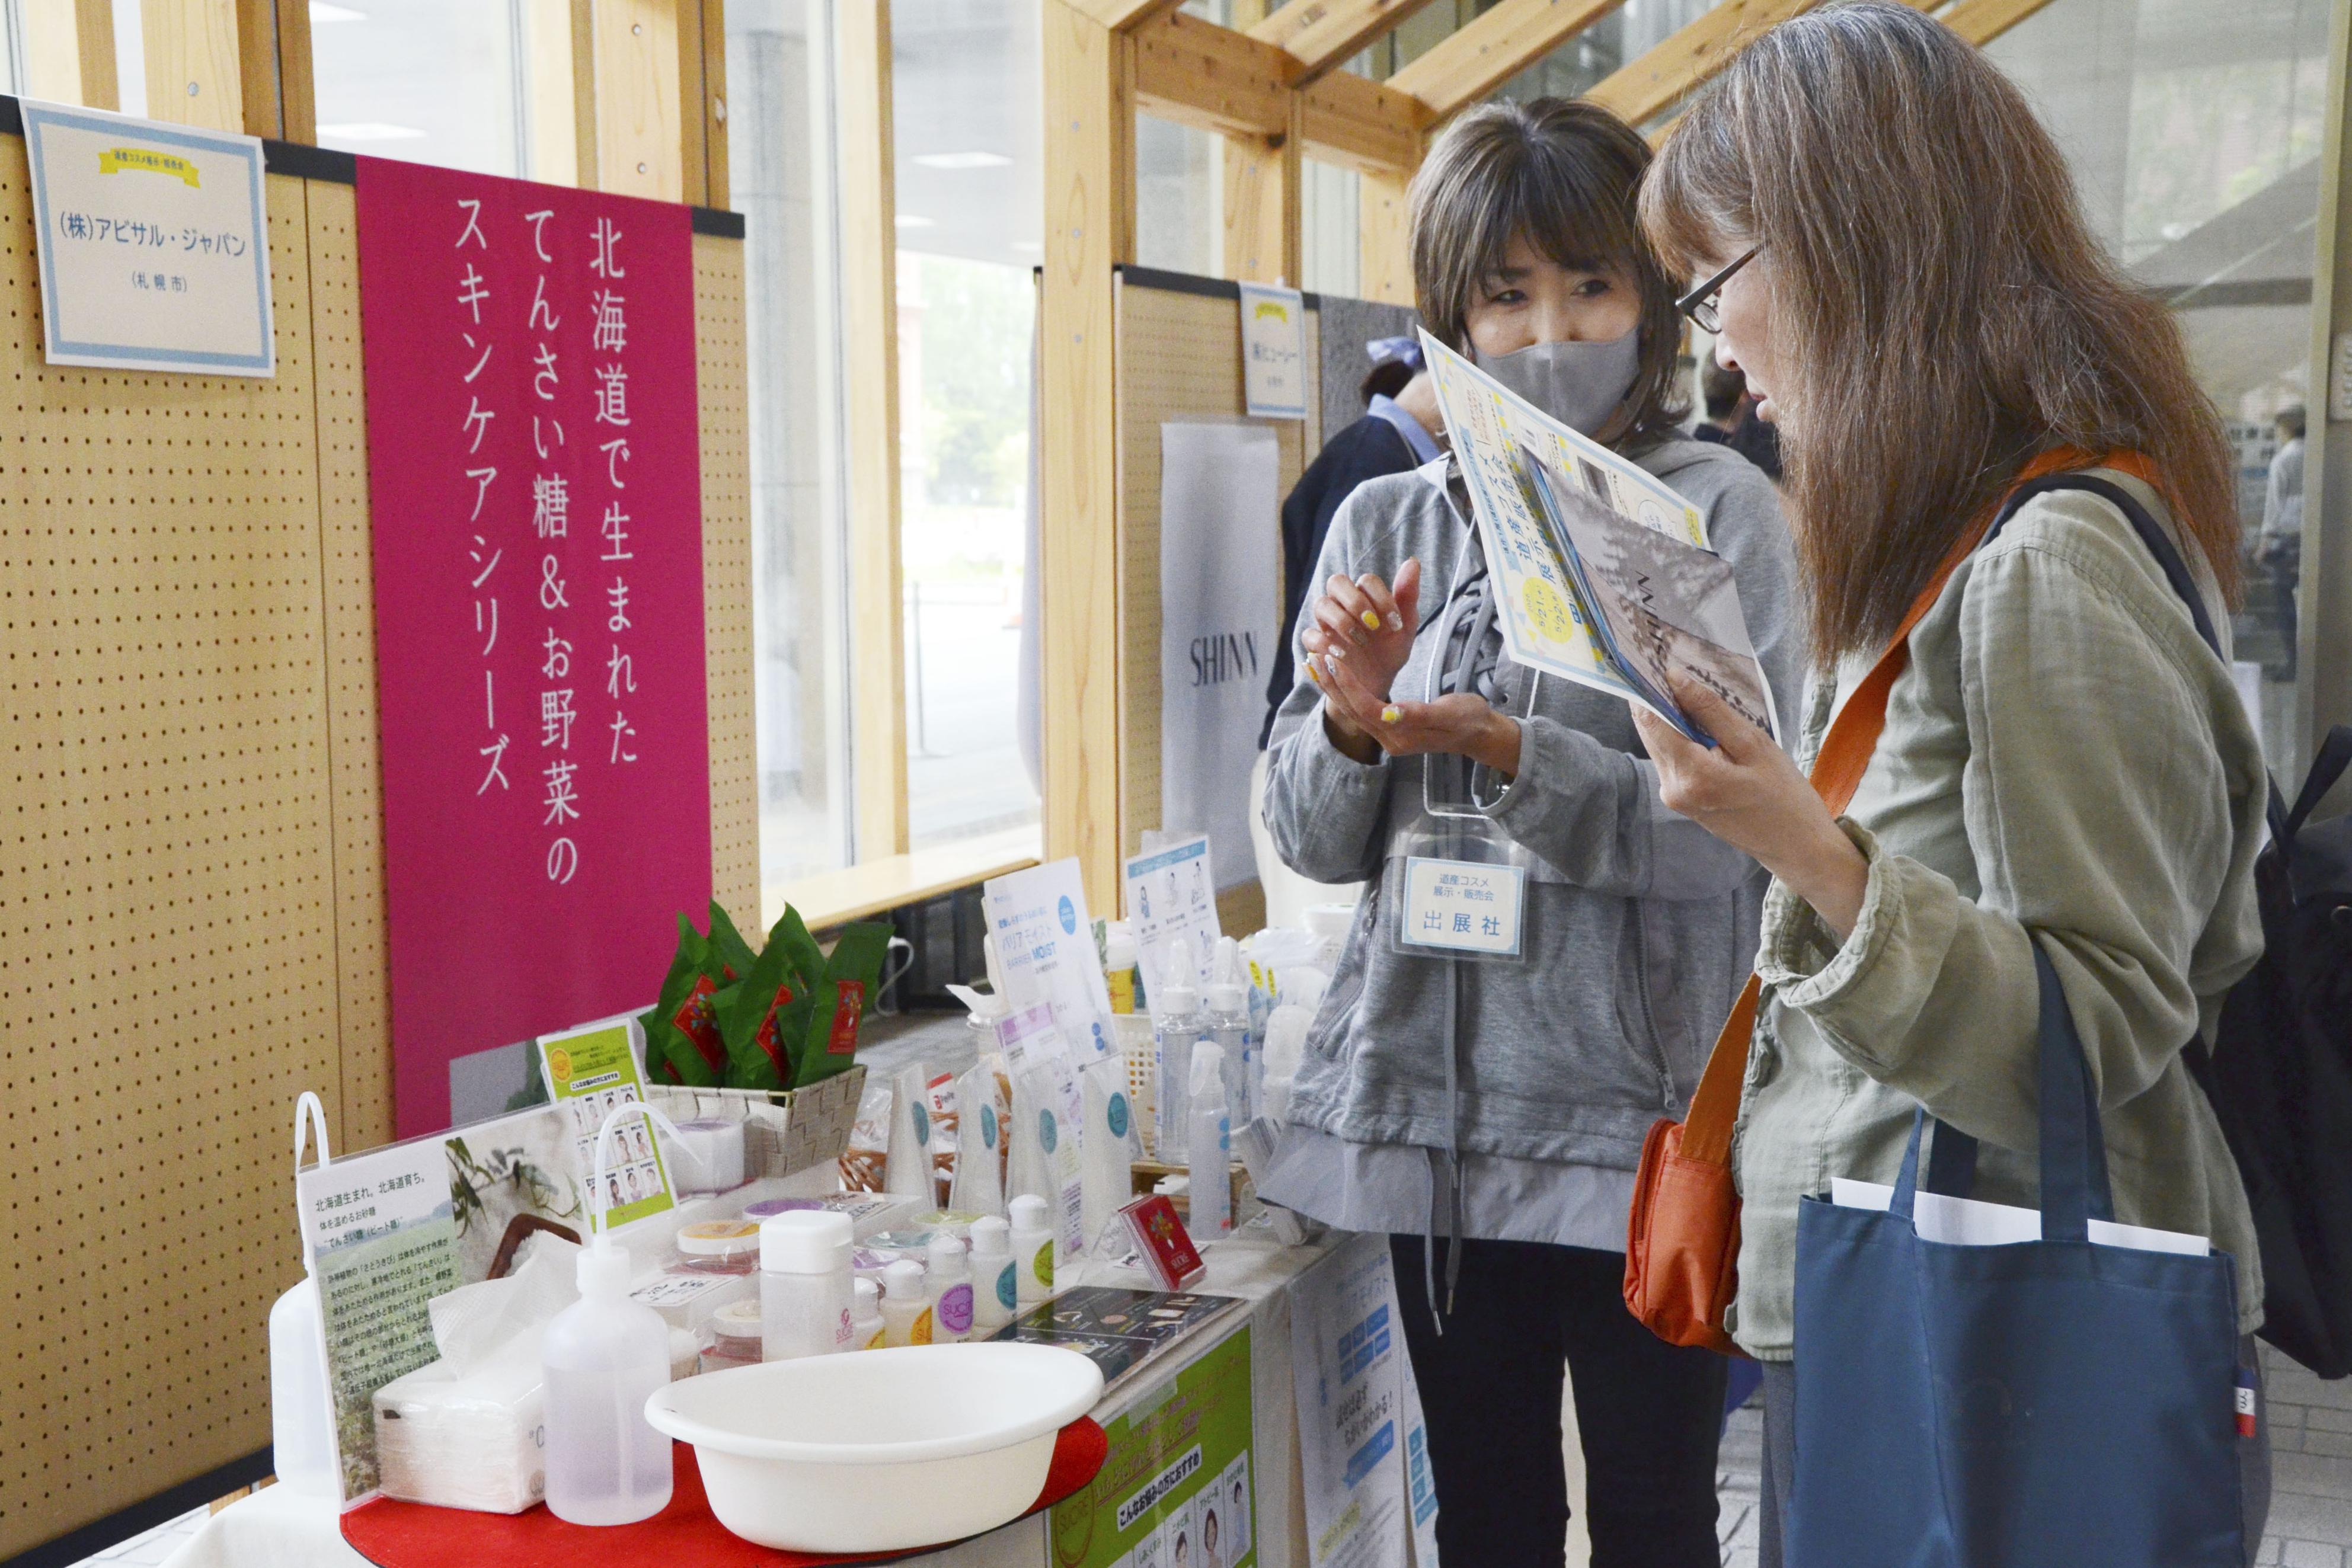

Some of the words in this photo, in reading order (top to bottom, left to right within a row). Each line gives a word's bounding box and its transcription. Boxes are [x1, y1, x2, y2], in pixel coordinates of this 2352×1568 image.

[60, 210, 246, 257] (株)アビサル・ジャパン
[132, 271, 187, 293] (札幌市)
[455, 199, 510, 796] スキンケアシリーズ
[590, 217, 637, 764] 北海道で生まれた
[1479, 453, 1533, 564] 道産コスメ
[525, 210, 580, 884] てんさい糖&お野菜の
[1432, 885, 1494, 902] 展示・販売会
[1440, 872, 1490, 888] 道産コスメ
[1423, 910, 1500, 937] 出展社
[315, 1187, 374, 1212] 北海道生まれ。
